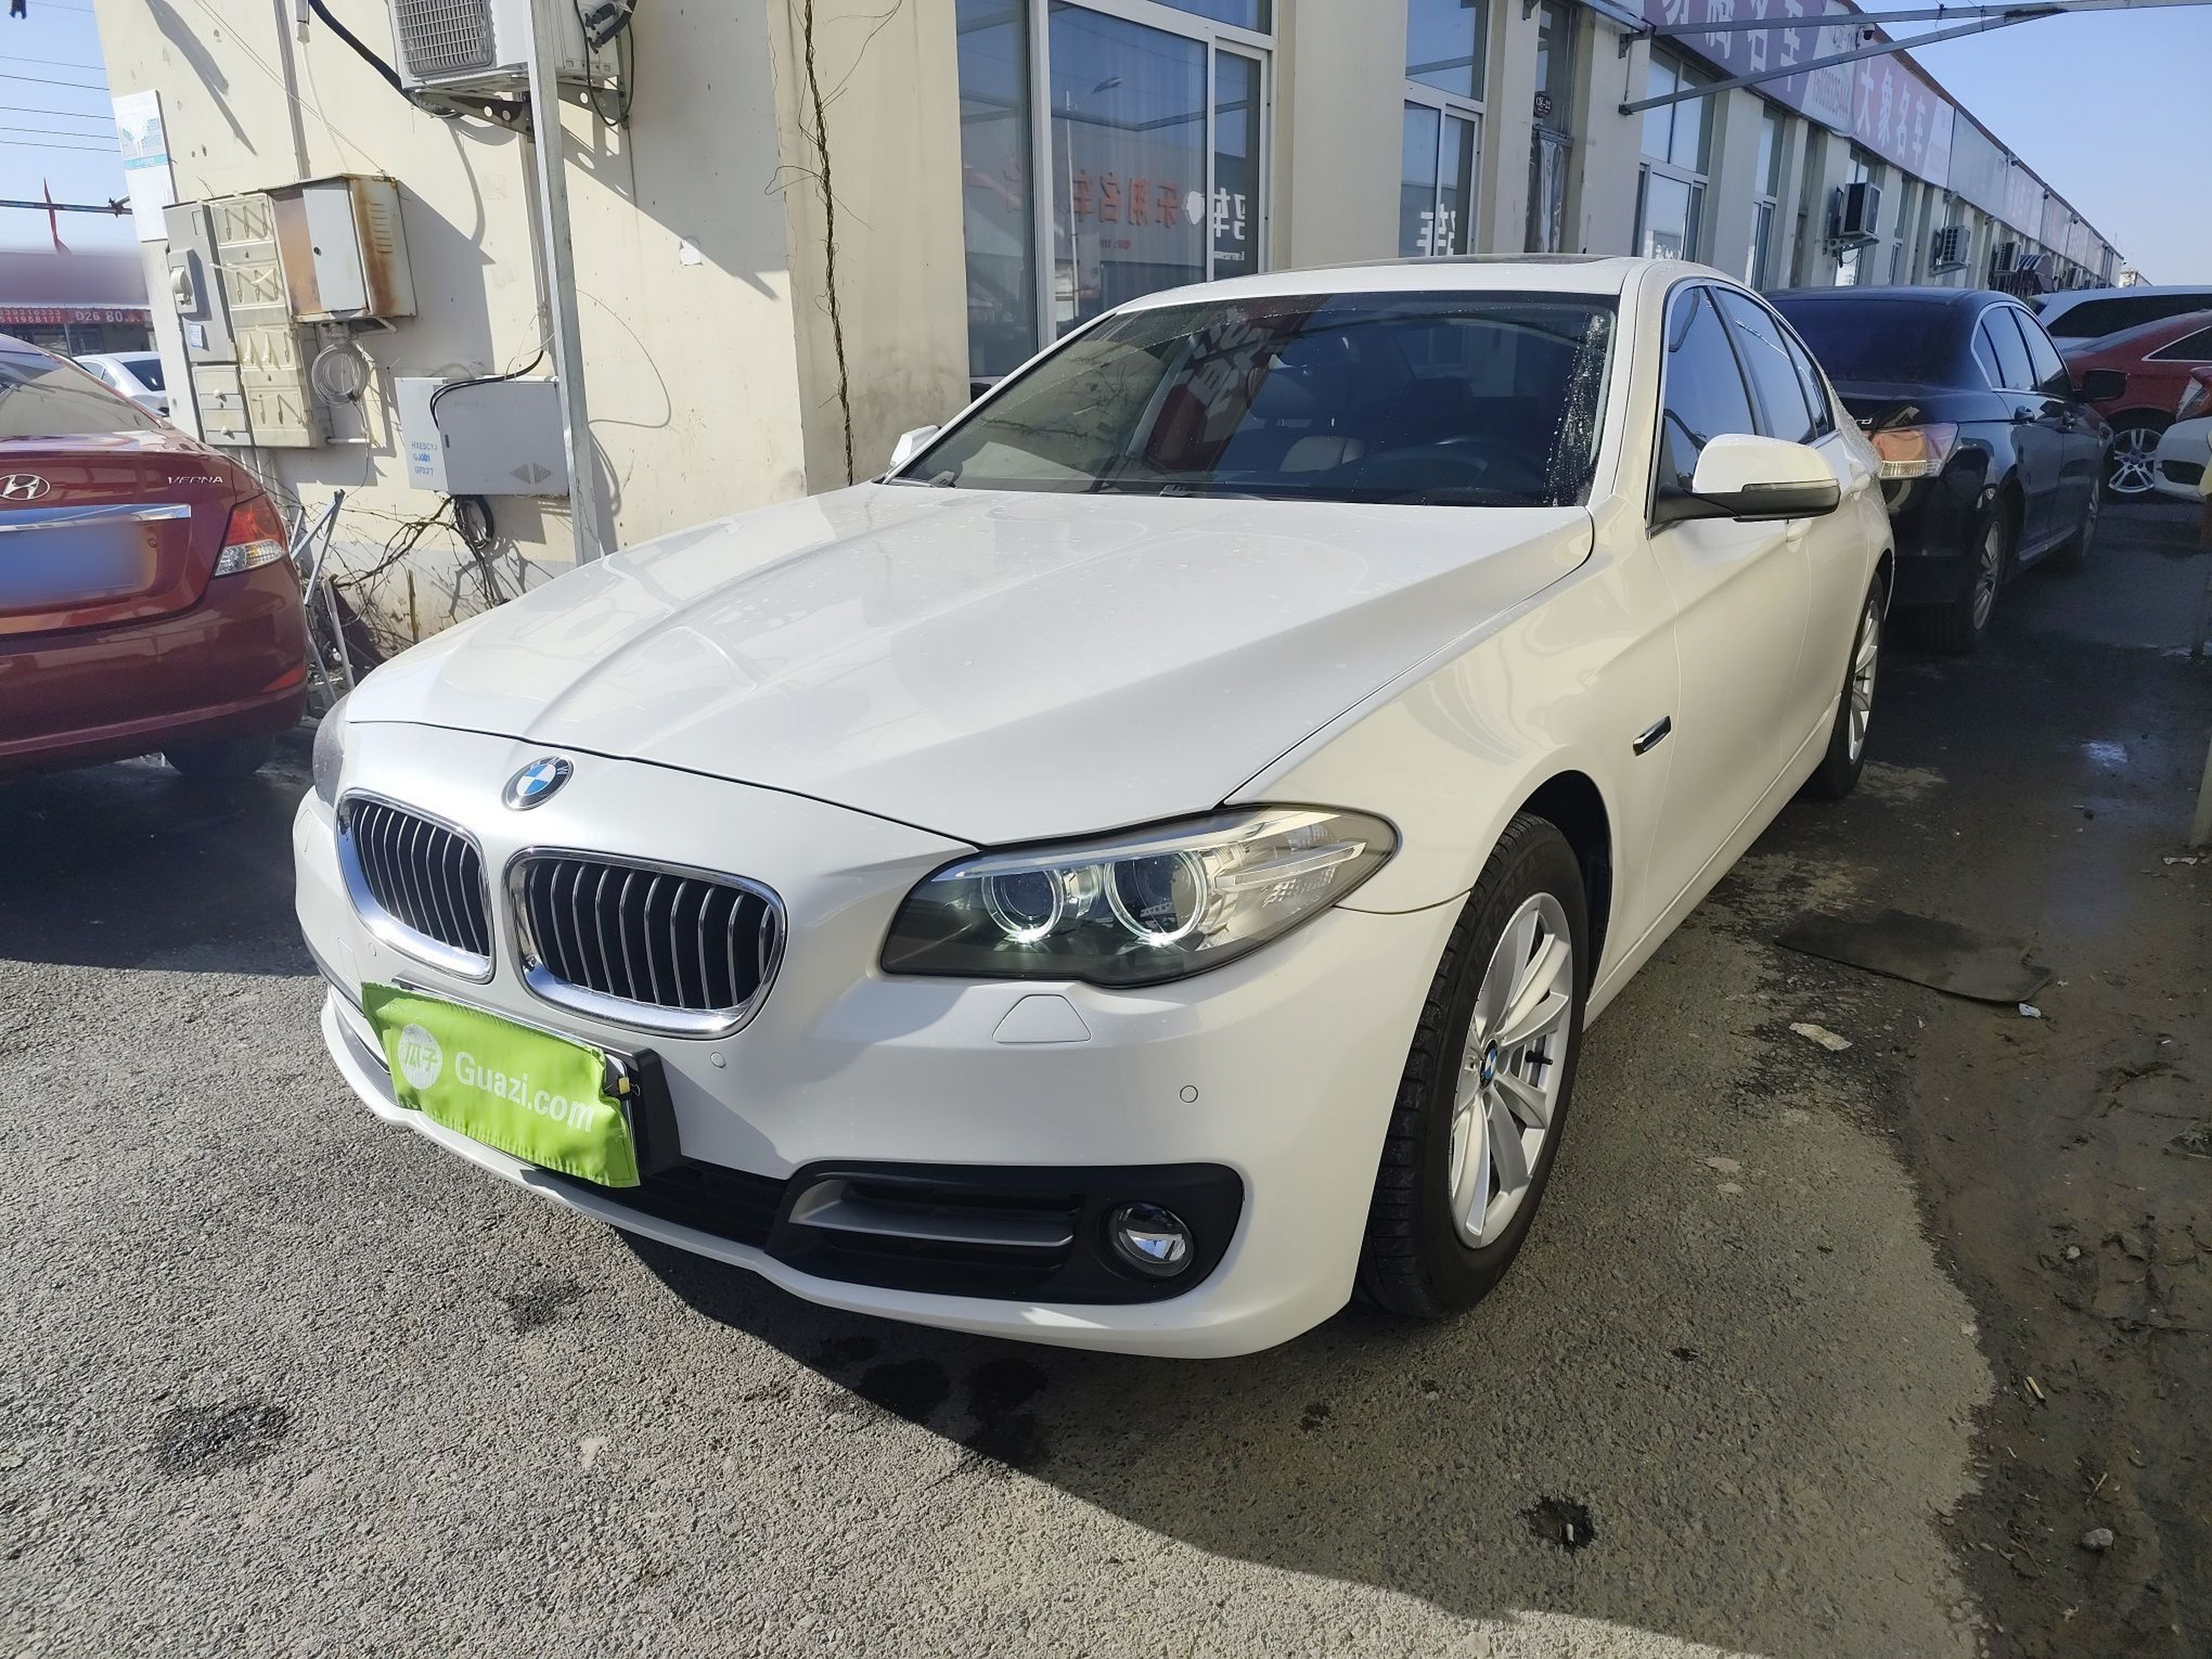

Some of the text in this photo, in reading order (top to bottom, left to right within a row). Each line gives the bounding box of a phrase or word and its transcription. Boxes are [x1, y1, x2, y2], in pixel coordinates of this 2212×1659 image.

[1856, 56, 1926, 167] 大象名车
[75, 311, 100, 321] D26
[454, 1051, 594, 1132] Guazi.com
